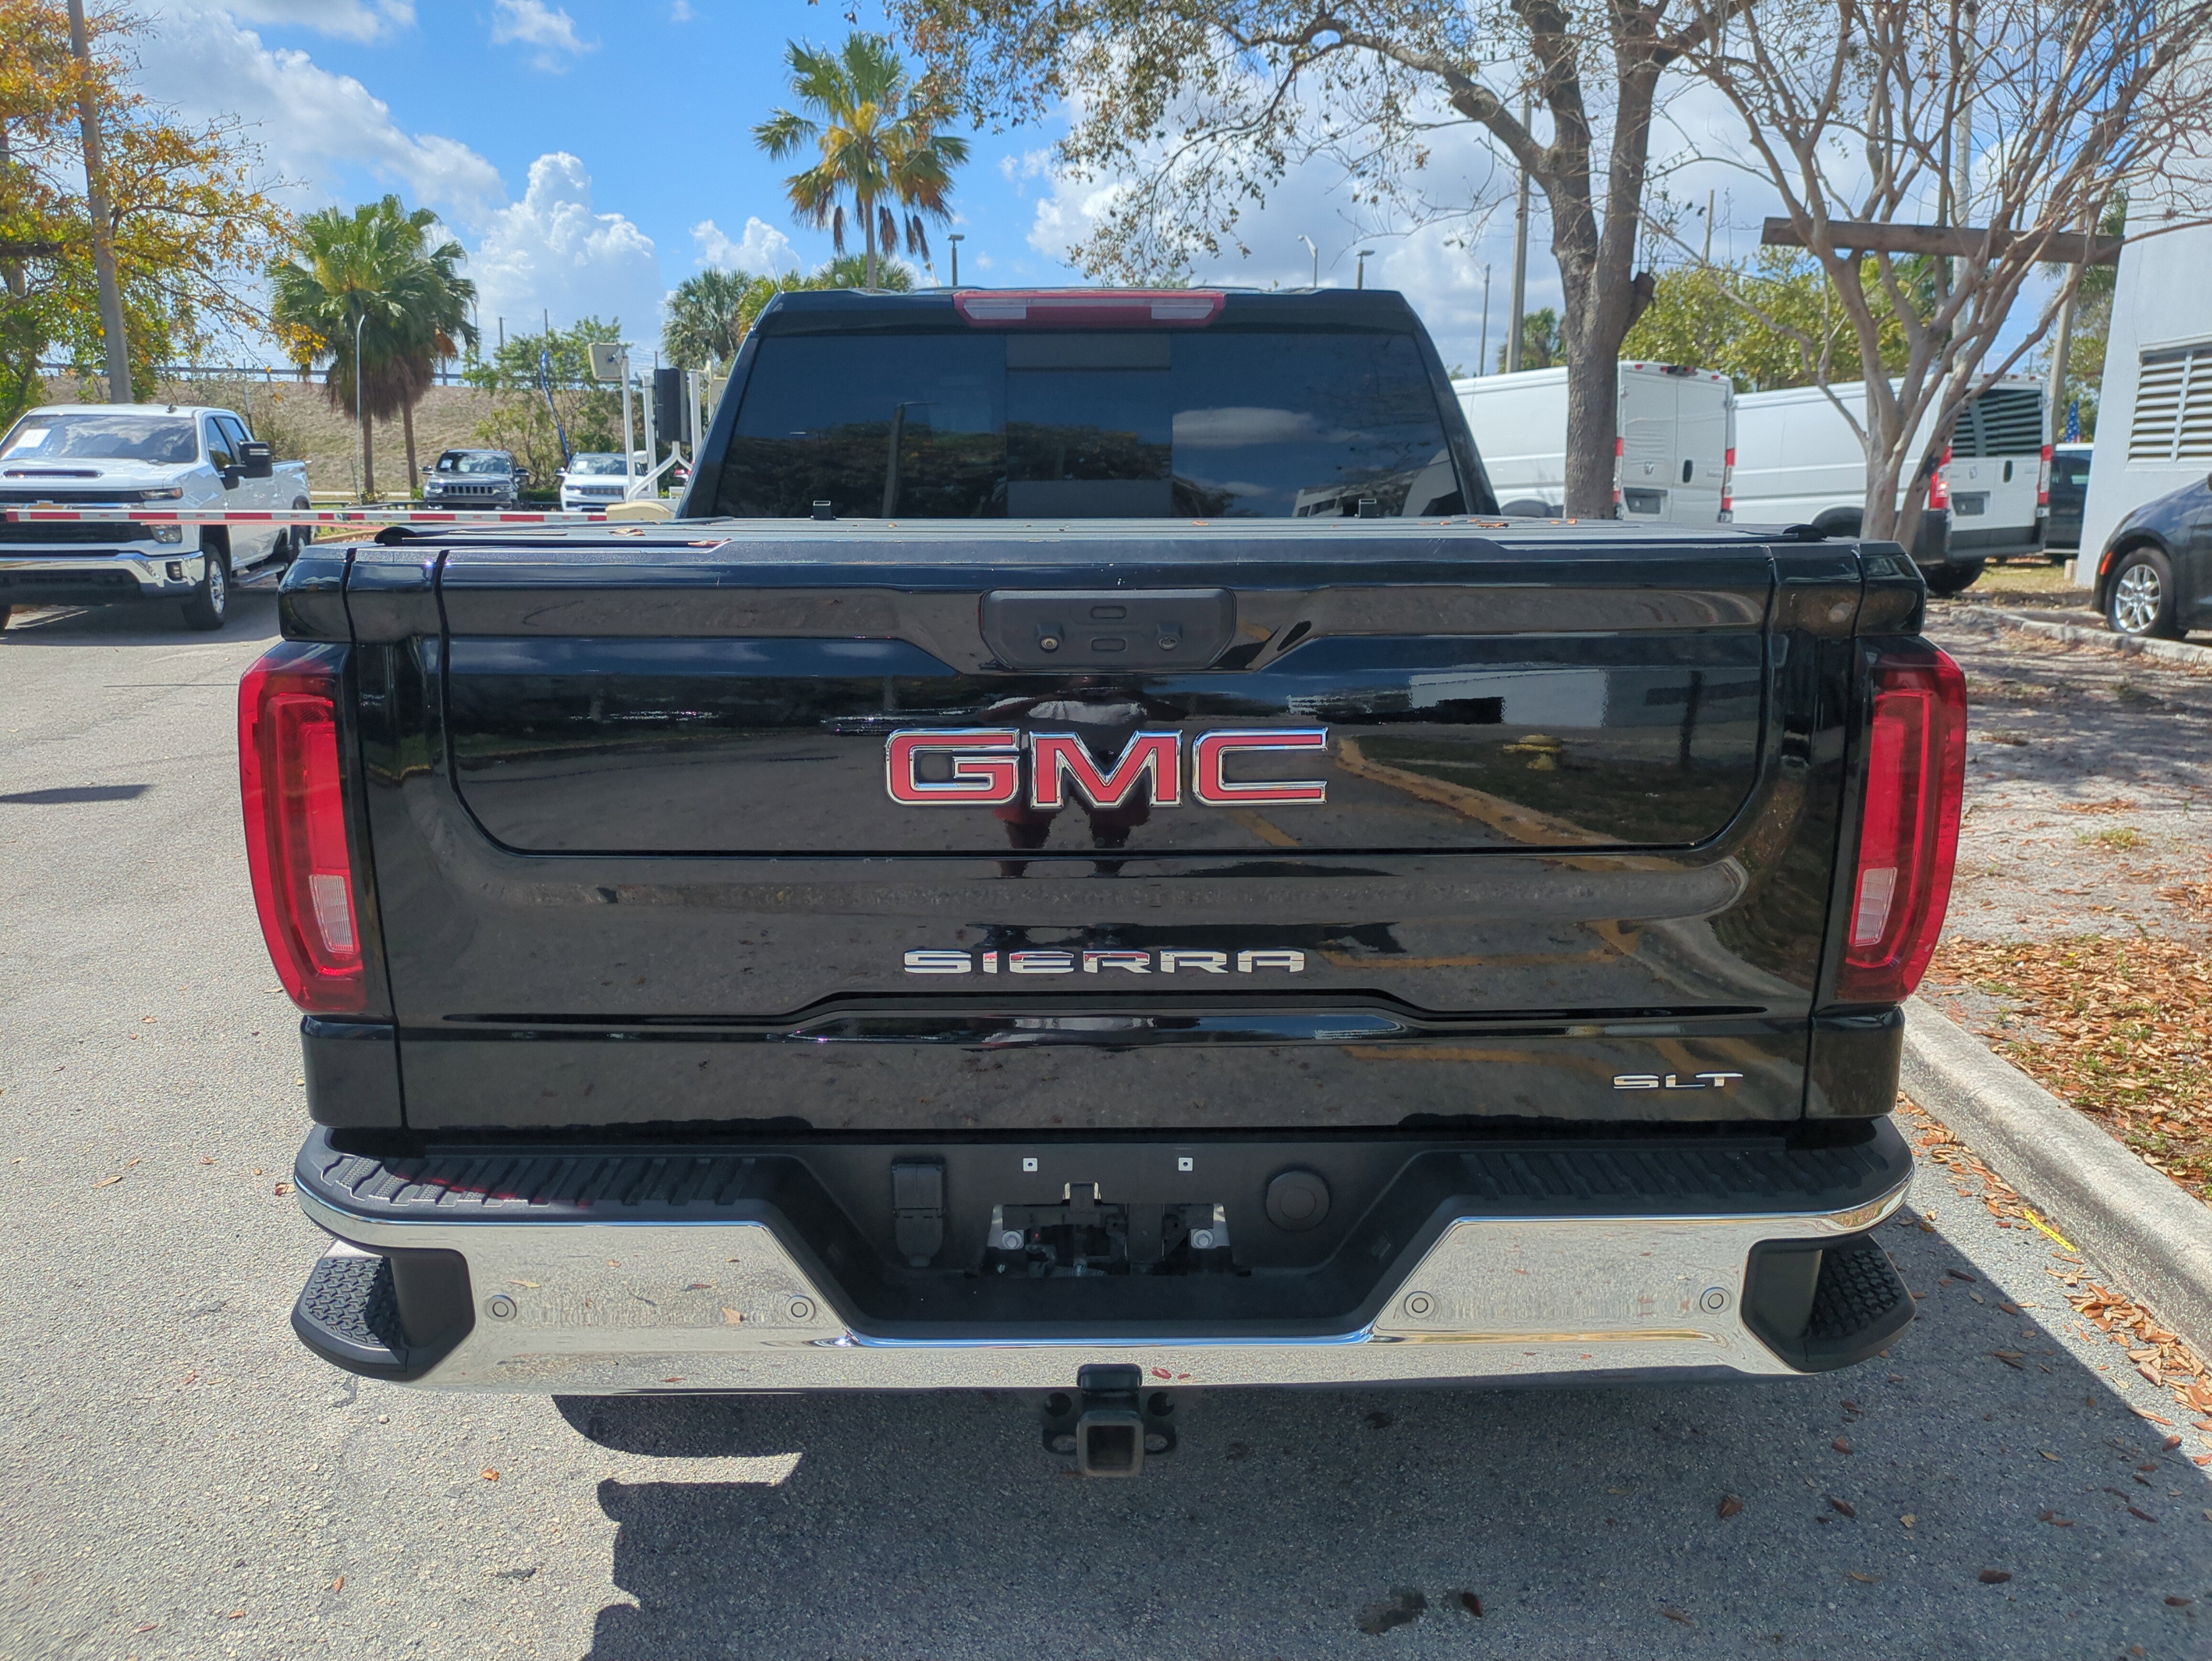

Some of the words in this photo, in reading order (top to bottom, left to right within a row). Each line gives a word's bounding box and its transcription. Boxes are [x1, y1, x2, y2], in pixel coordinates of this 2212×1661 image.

[885, 727, 1328, 808] GMC
[904, 950, 1305, 974] SIERRA
[1613, 1072, 1743, 1089] SLT
